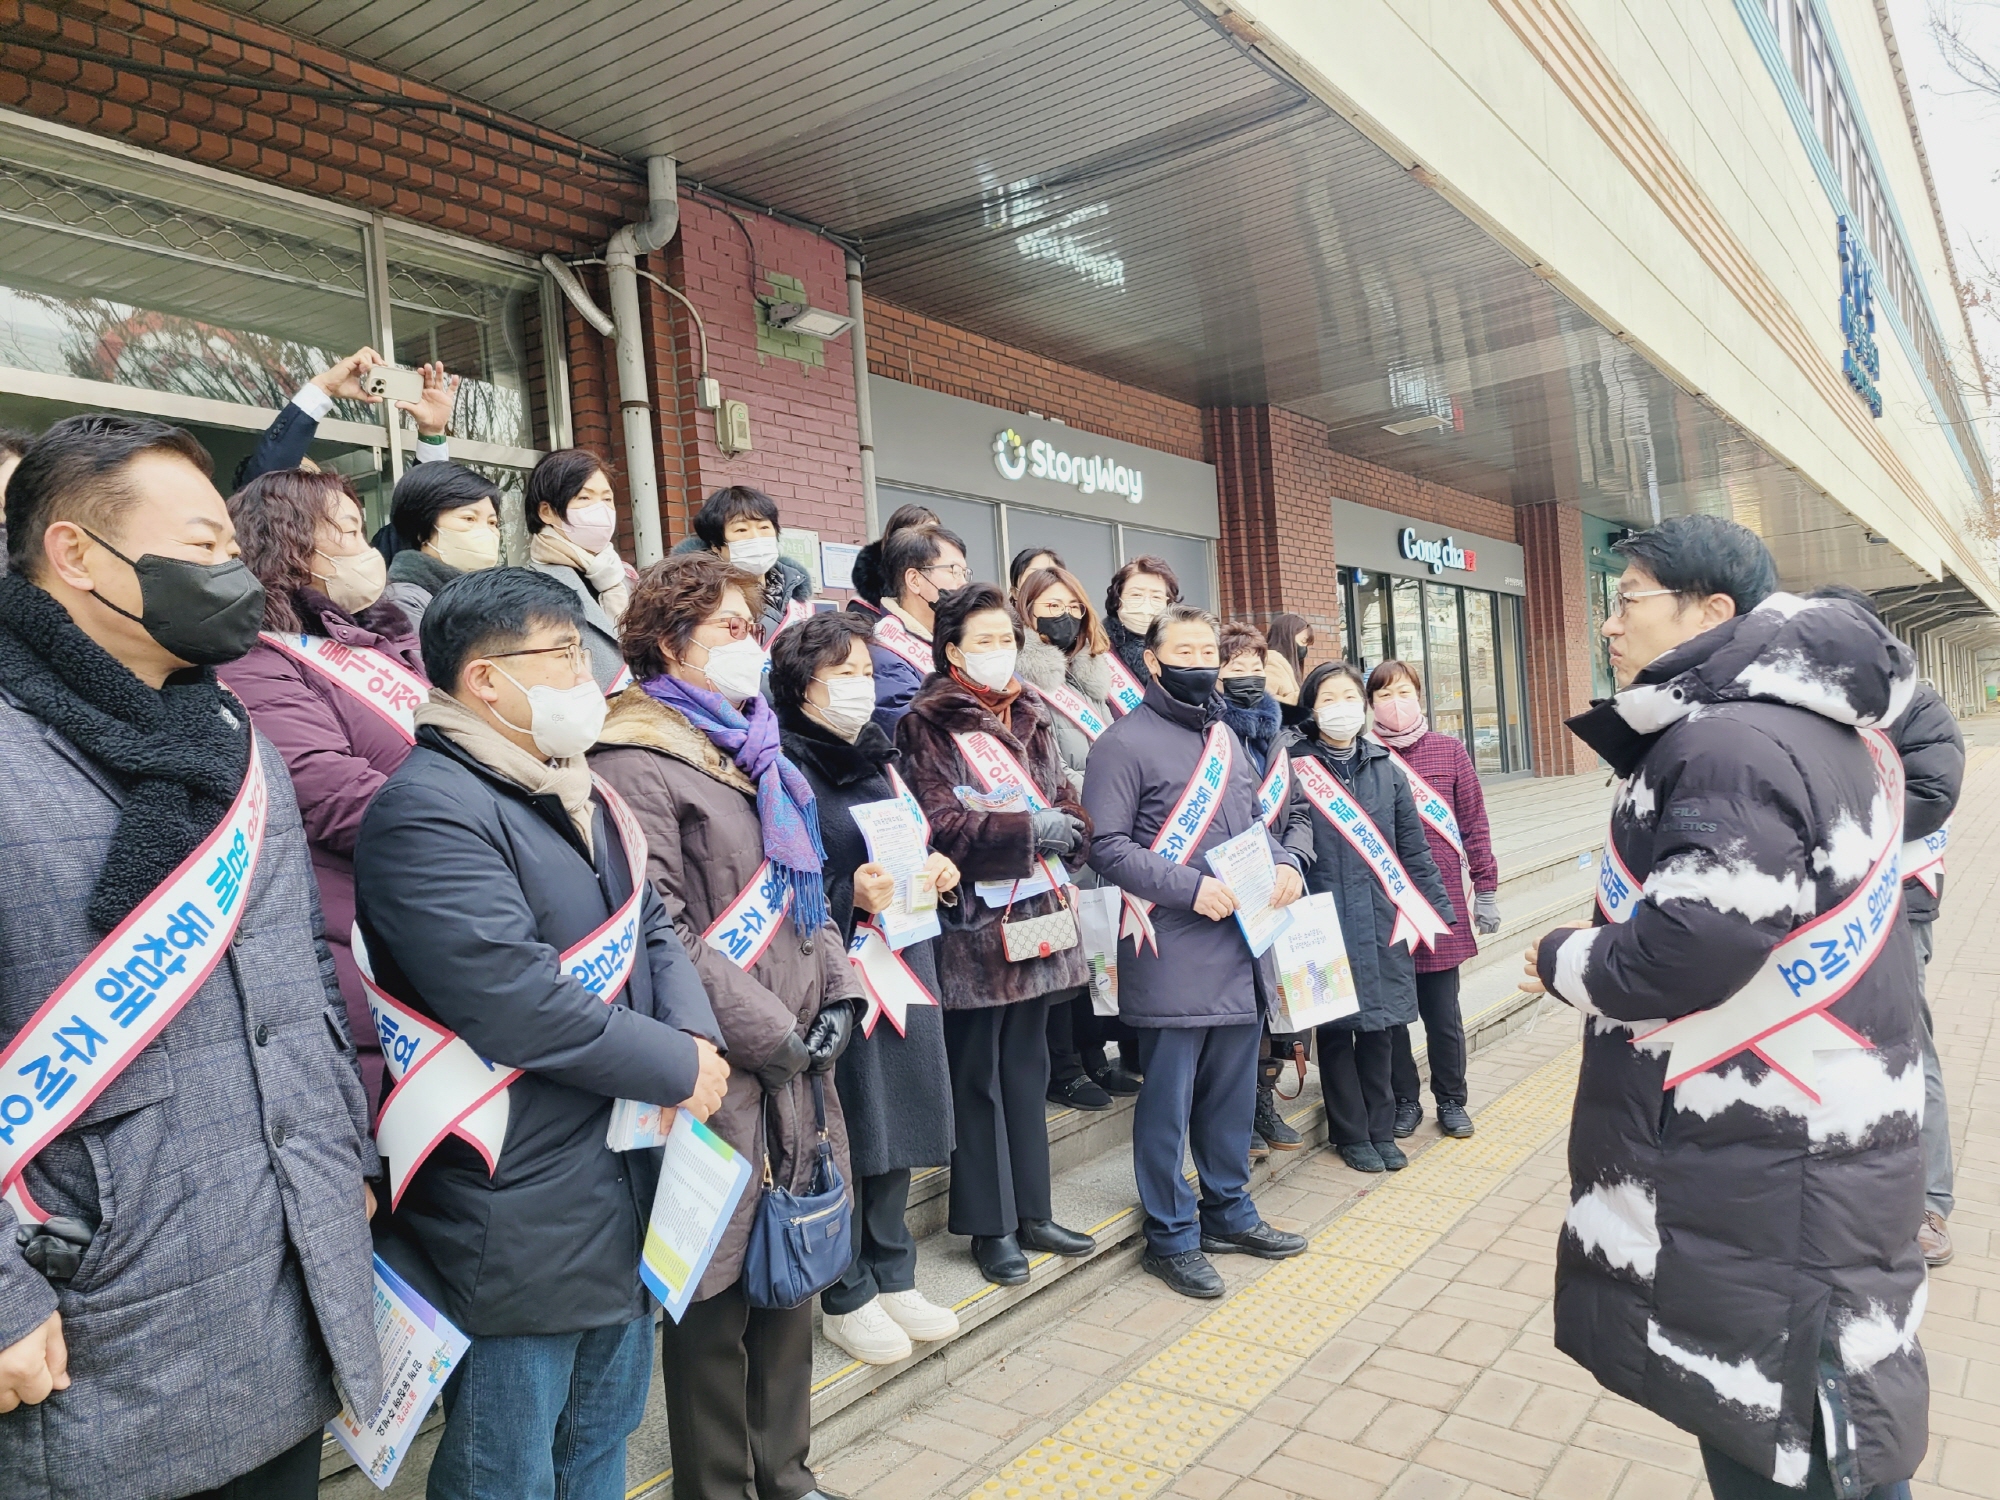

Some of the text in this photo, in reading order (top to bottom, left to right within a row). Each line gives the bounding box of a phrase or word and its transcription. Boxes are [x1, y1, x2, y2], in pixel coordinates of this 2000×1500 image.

[1400, 527, 1442, 574] Gong
[1442, 536, 1465, 570] cha
[1055, 689, 1103, 734] 안정 함께
[1204, 756, 1224, 790] 함께
[1177, 785, 1213, 836] 동참해
[1292, 758, 1406, 896] 물가안정 함께 동참해 주세요
[1424, 799, 1449, 822] 함께
[1672, 807, 1701, 817] FILA
[1158, 832, 1187, 862] 주세
[206, 827, 250, 916] 함께
[717, 906, 766, 960] 주세
[95, 901, 216, 1029] 동참해
[1777, 916, 1867, 997] 주세요
[0, 1014, 108, 1146] 주세요
[406, 1359, 422, 1381] 함께
[392, 1379, 411, 1409] 동참해
[395, 1389, 417, 1428] 물가안정!
